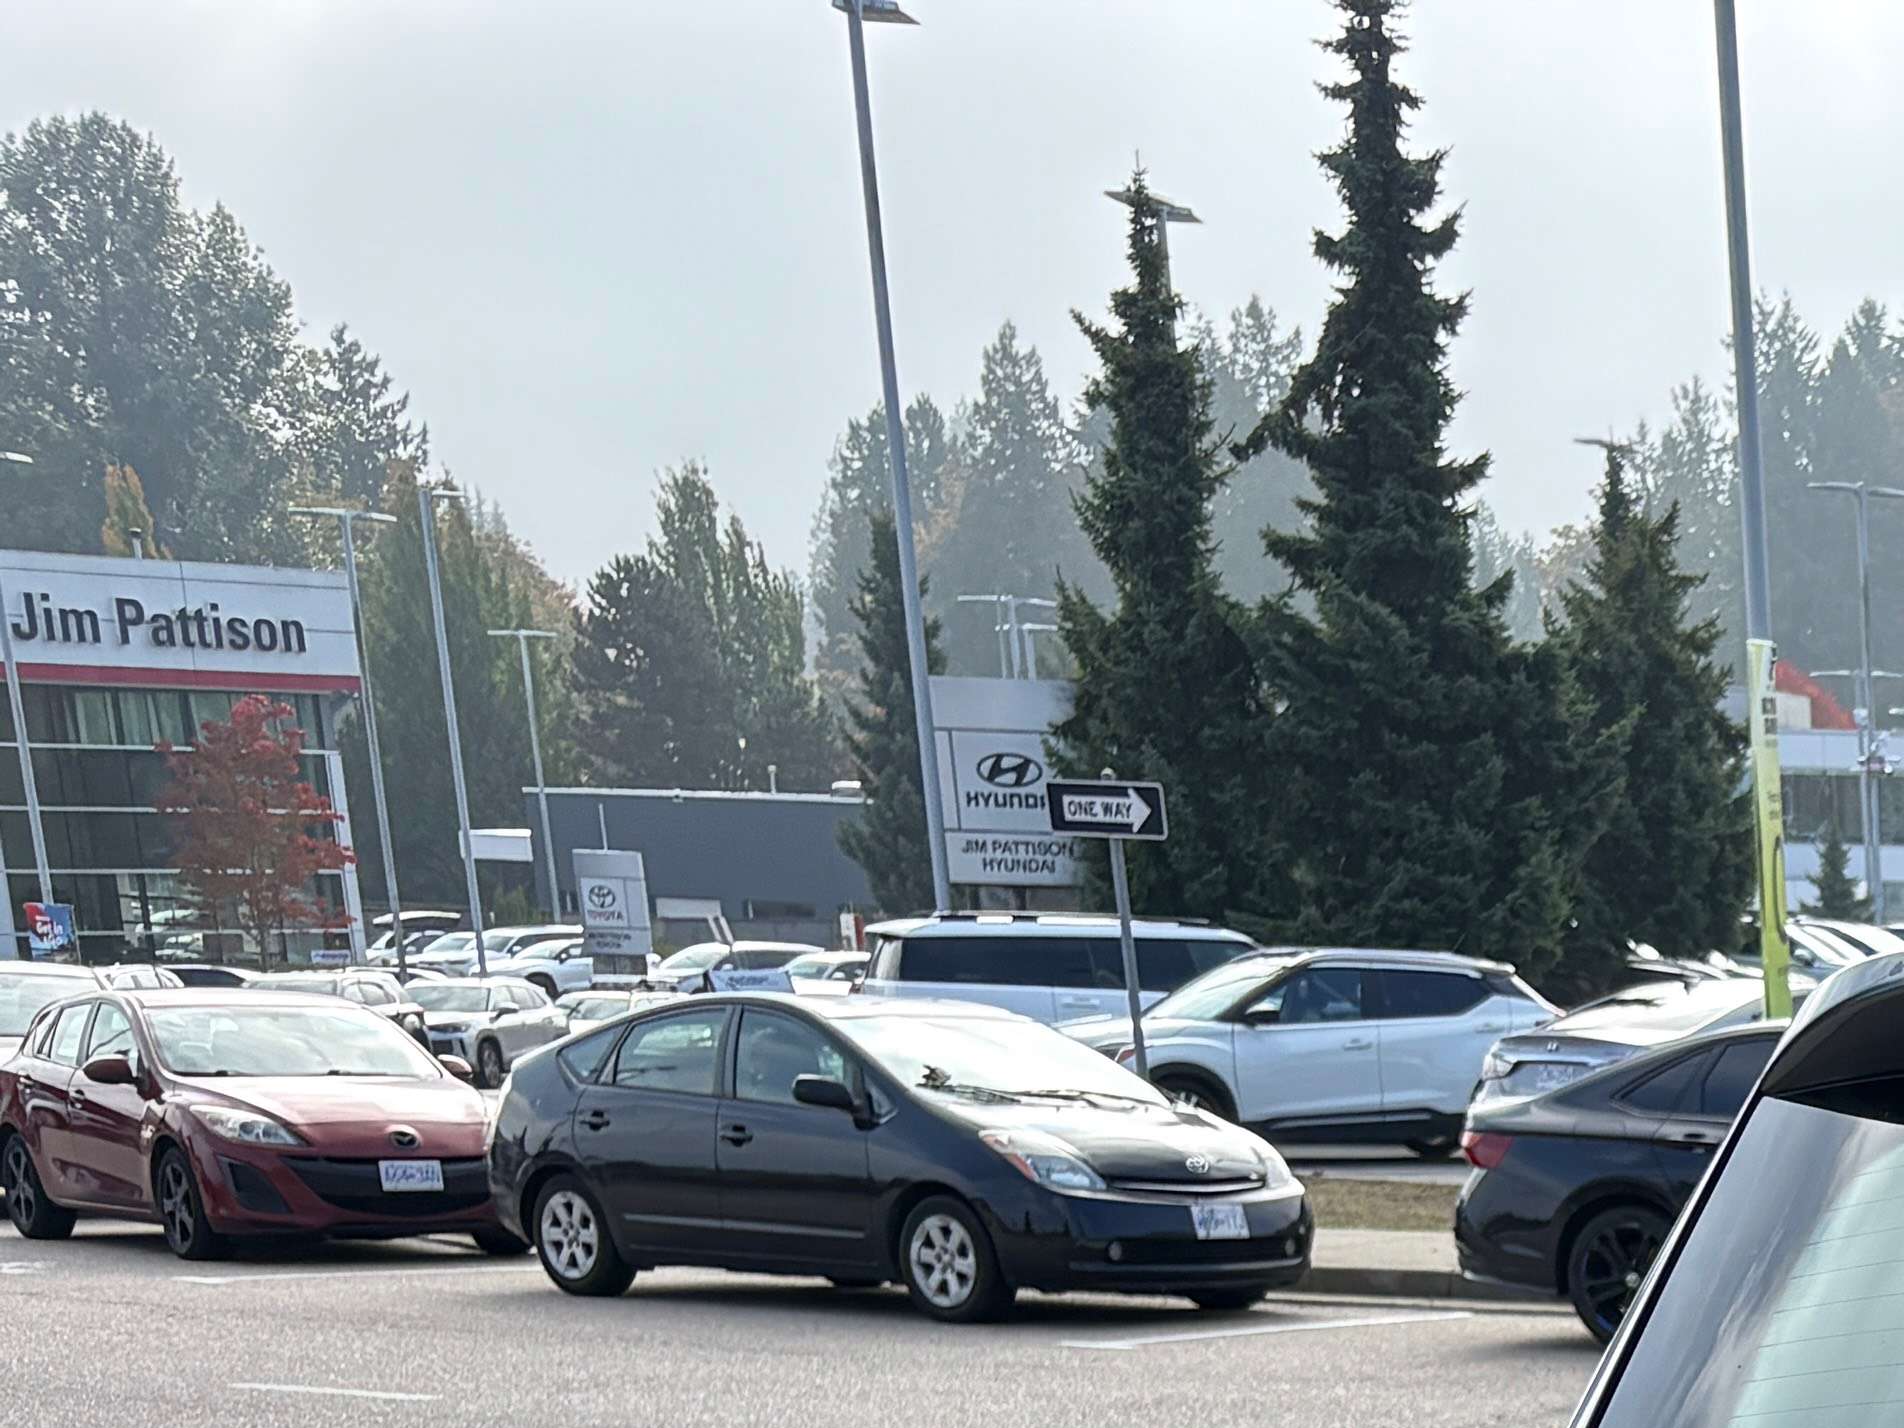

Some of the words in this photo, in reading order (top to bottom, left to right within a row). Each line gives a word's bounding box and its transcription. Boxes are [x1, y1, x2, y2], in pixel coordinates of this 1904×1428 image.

[11, 592, 101, 643] Jim
[114, 597, 307, 653] Pattison
[966, 791, 1047, 809] HYUND
[1067, 799, 1098, 817] ONE
[1100, 801, 1133, 820] WAY
[962, 840, 987, 855] JIM
[991, 841, 1075, 857] PATTISON
[982, 859, 1056, 874] HYUNDAI
